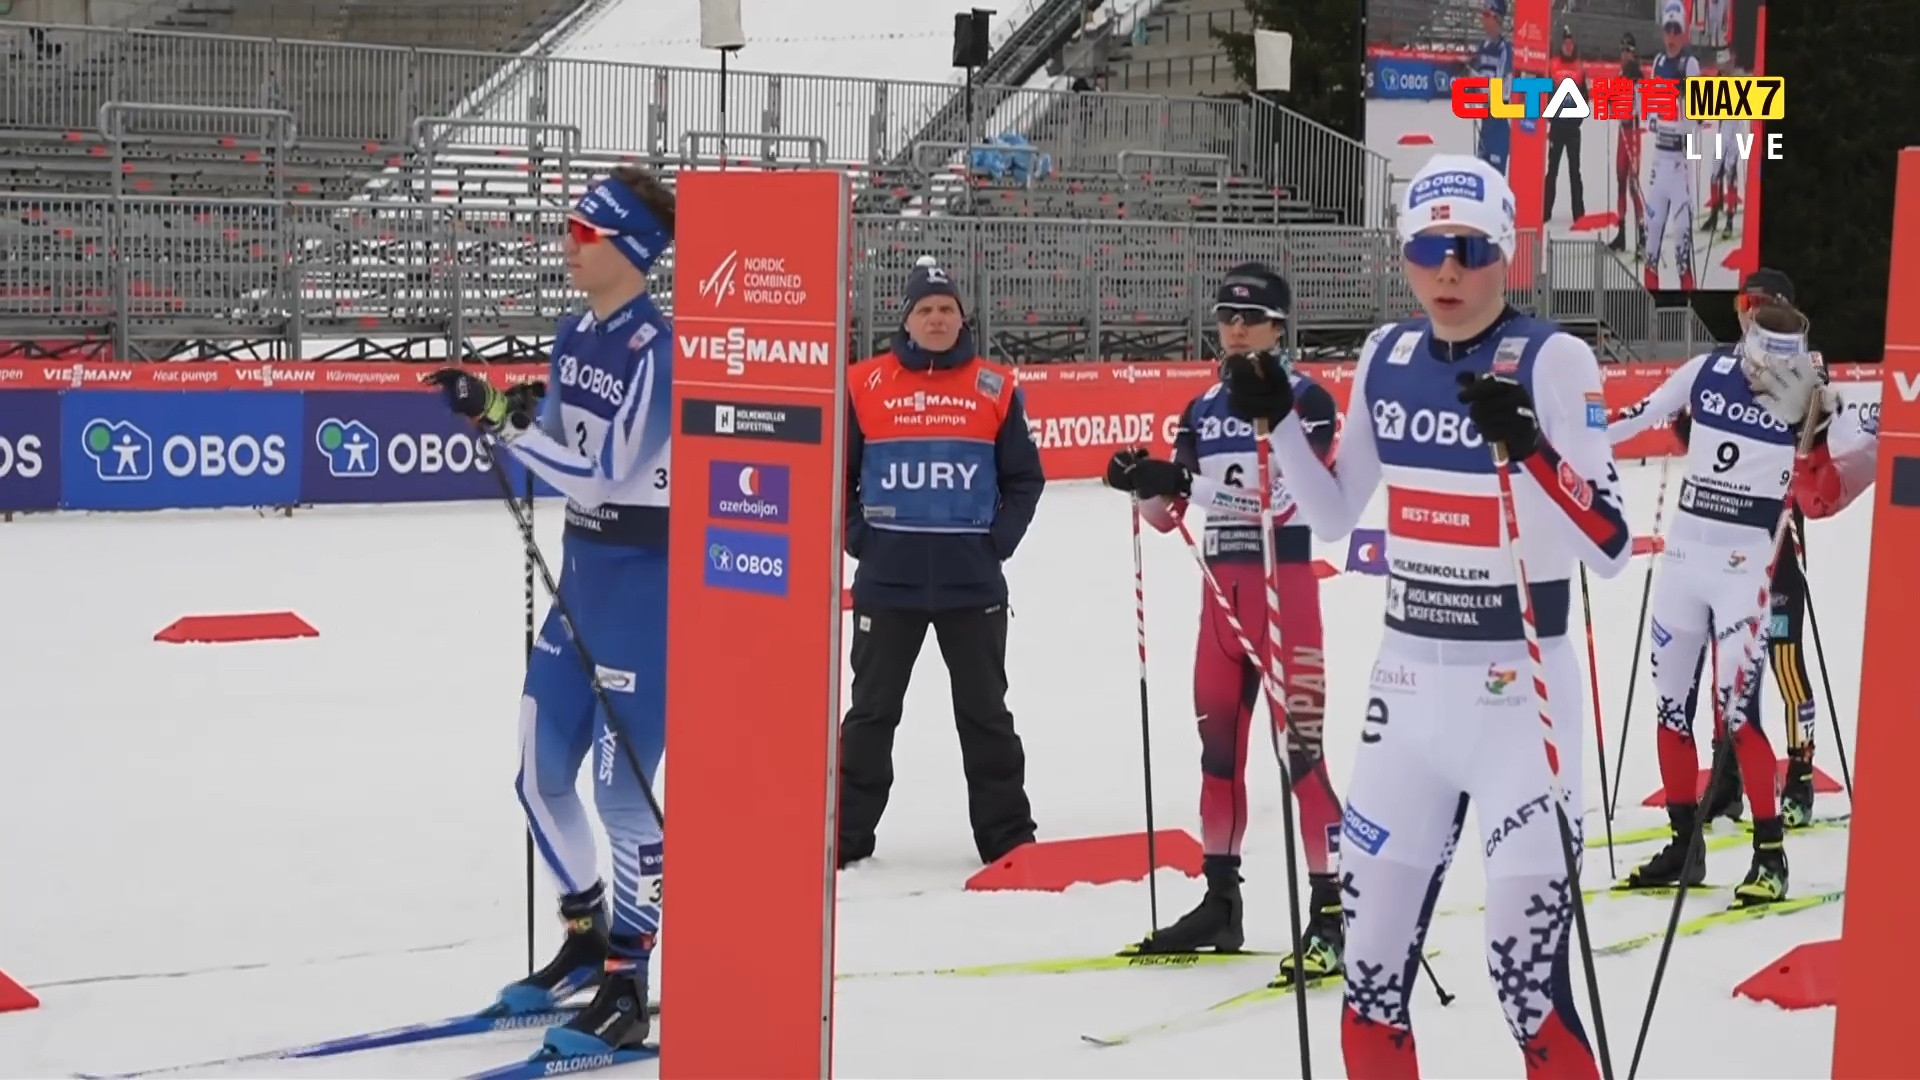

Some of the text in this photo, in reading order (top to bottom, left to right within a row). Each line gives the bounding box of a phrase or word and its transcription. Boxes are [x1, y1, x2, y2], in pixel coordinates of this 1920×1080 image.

[1433, 174, 1477, 188] OBOS
[744, 257, 785, 273] NORDIC
[743, 273, 801, 289] COMBINED
[743, 289, 807, 305] WORLD CUP
[679, 327, 829, 376] VIESSMANN
[43, 363, 132, 388] VIESSMANN
[153, 370, 219, 383] Heat pumps
[235, 363, 316, 388] VIESSMANN
[326, 370, 400, 384] Wärmepumpen
[578, 364, 625, 406] OBOS
[1892, 372, 1920, 402] V
[884, 391, 977, 412] VIESSMANN
[894, 414, 967, 426] Heat pumps
[1027, 413, 1155, 449] GATORADE
[1410, 408, 1483, 448] OBO
[162, 434, 286, 477] OBOS
[387, 433, 496, 474] OBOS
[1712, 441, 1740, 474] 9
[653, 468, 668, 490] 3
[881, 462, 979, 490] JURY
[1779, 469, 1790, 486] 9
[719, 499, 778, 518] azerbaijan
[1402, 506, 1471, 527] BEST SKIER
[736, 554, 783, 577] OBOS
[1408, 588, 1503, 609] HOLMENKOLLEN
[1407, 604, 1480, 626] SKIFESTIVAL
[1288, 645, 1325, 760] JAPAN
[1346, 809, 1381, 841] OBOS
[1486, 794, 1550, 858] CRAFT
[650, 879, 662, 903] 3
[544, 1054, 614, 1075] SALOMON
